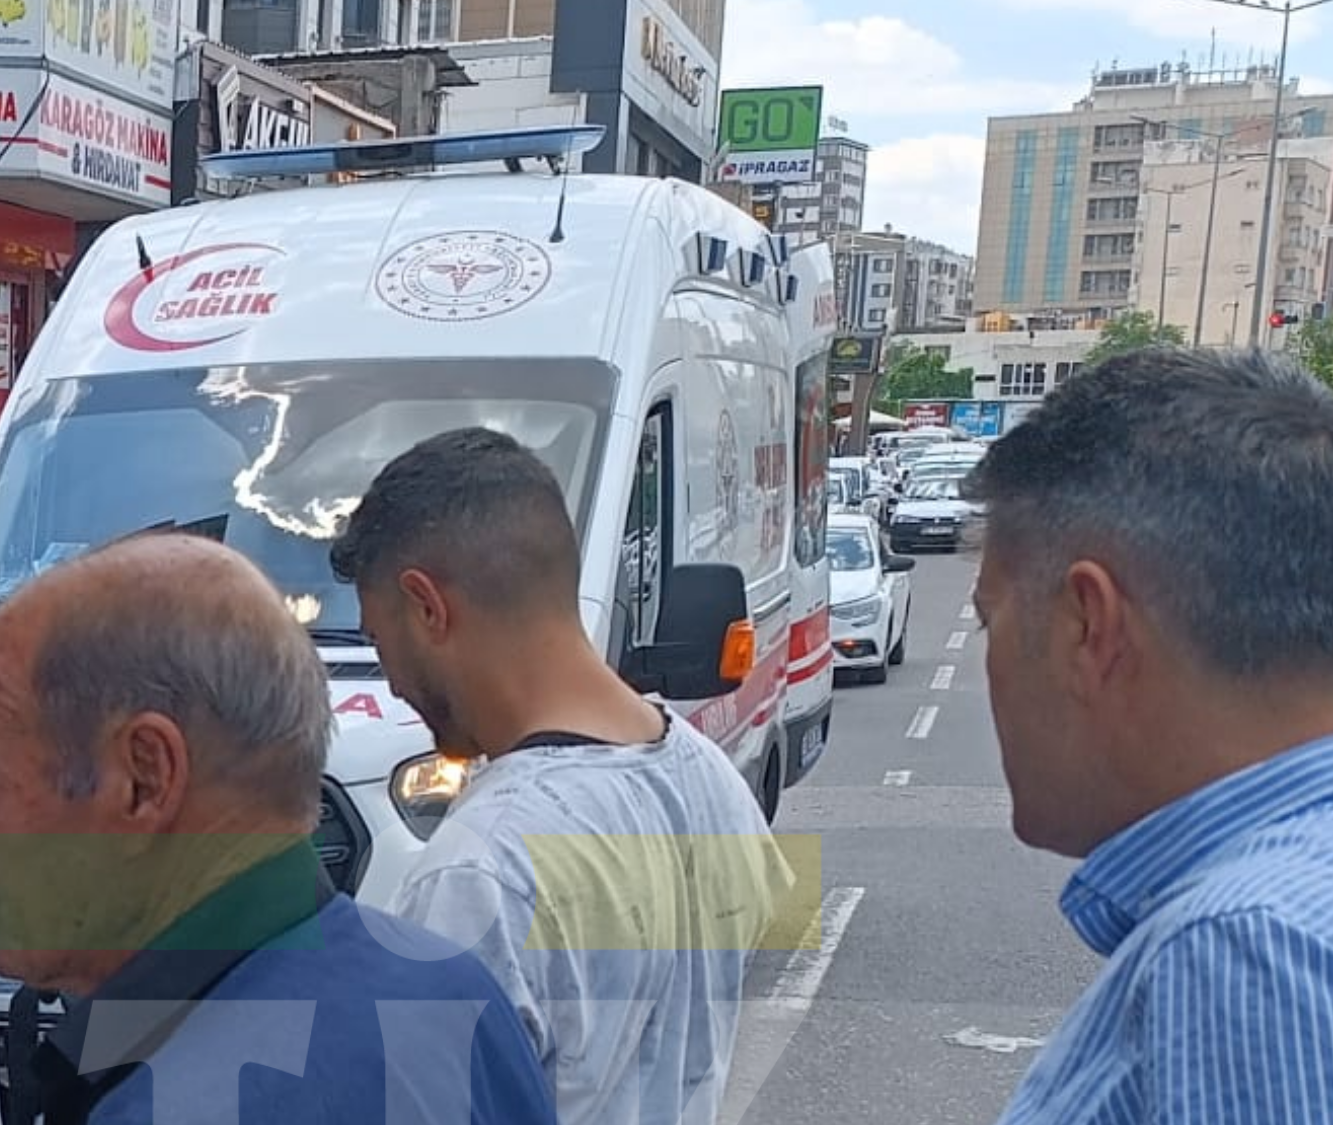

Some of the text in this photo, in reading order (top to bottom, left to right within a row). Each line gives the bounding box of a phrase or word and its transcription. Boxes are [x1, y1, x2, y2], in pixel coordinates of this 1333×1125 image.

[39, 88, 168, 166] KARAGÖZ MAKİNA
[728, 98, 793, 143] GO
[71, 143, 142, 192] & HIRDAVAT
[187, 264, 265, 292] ACİL
[154, 291, 279, 322] SAĞLIK
